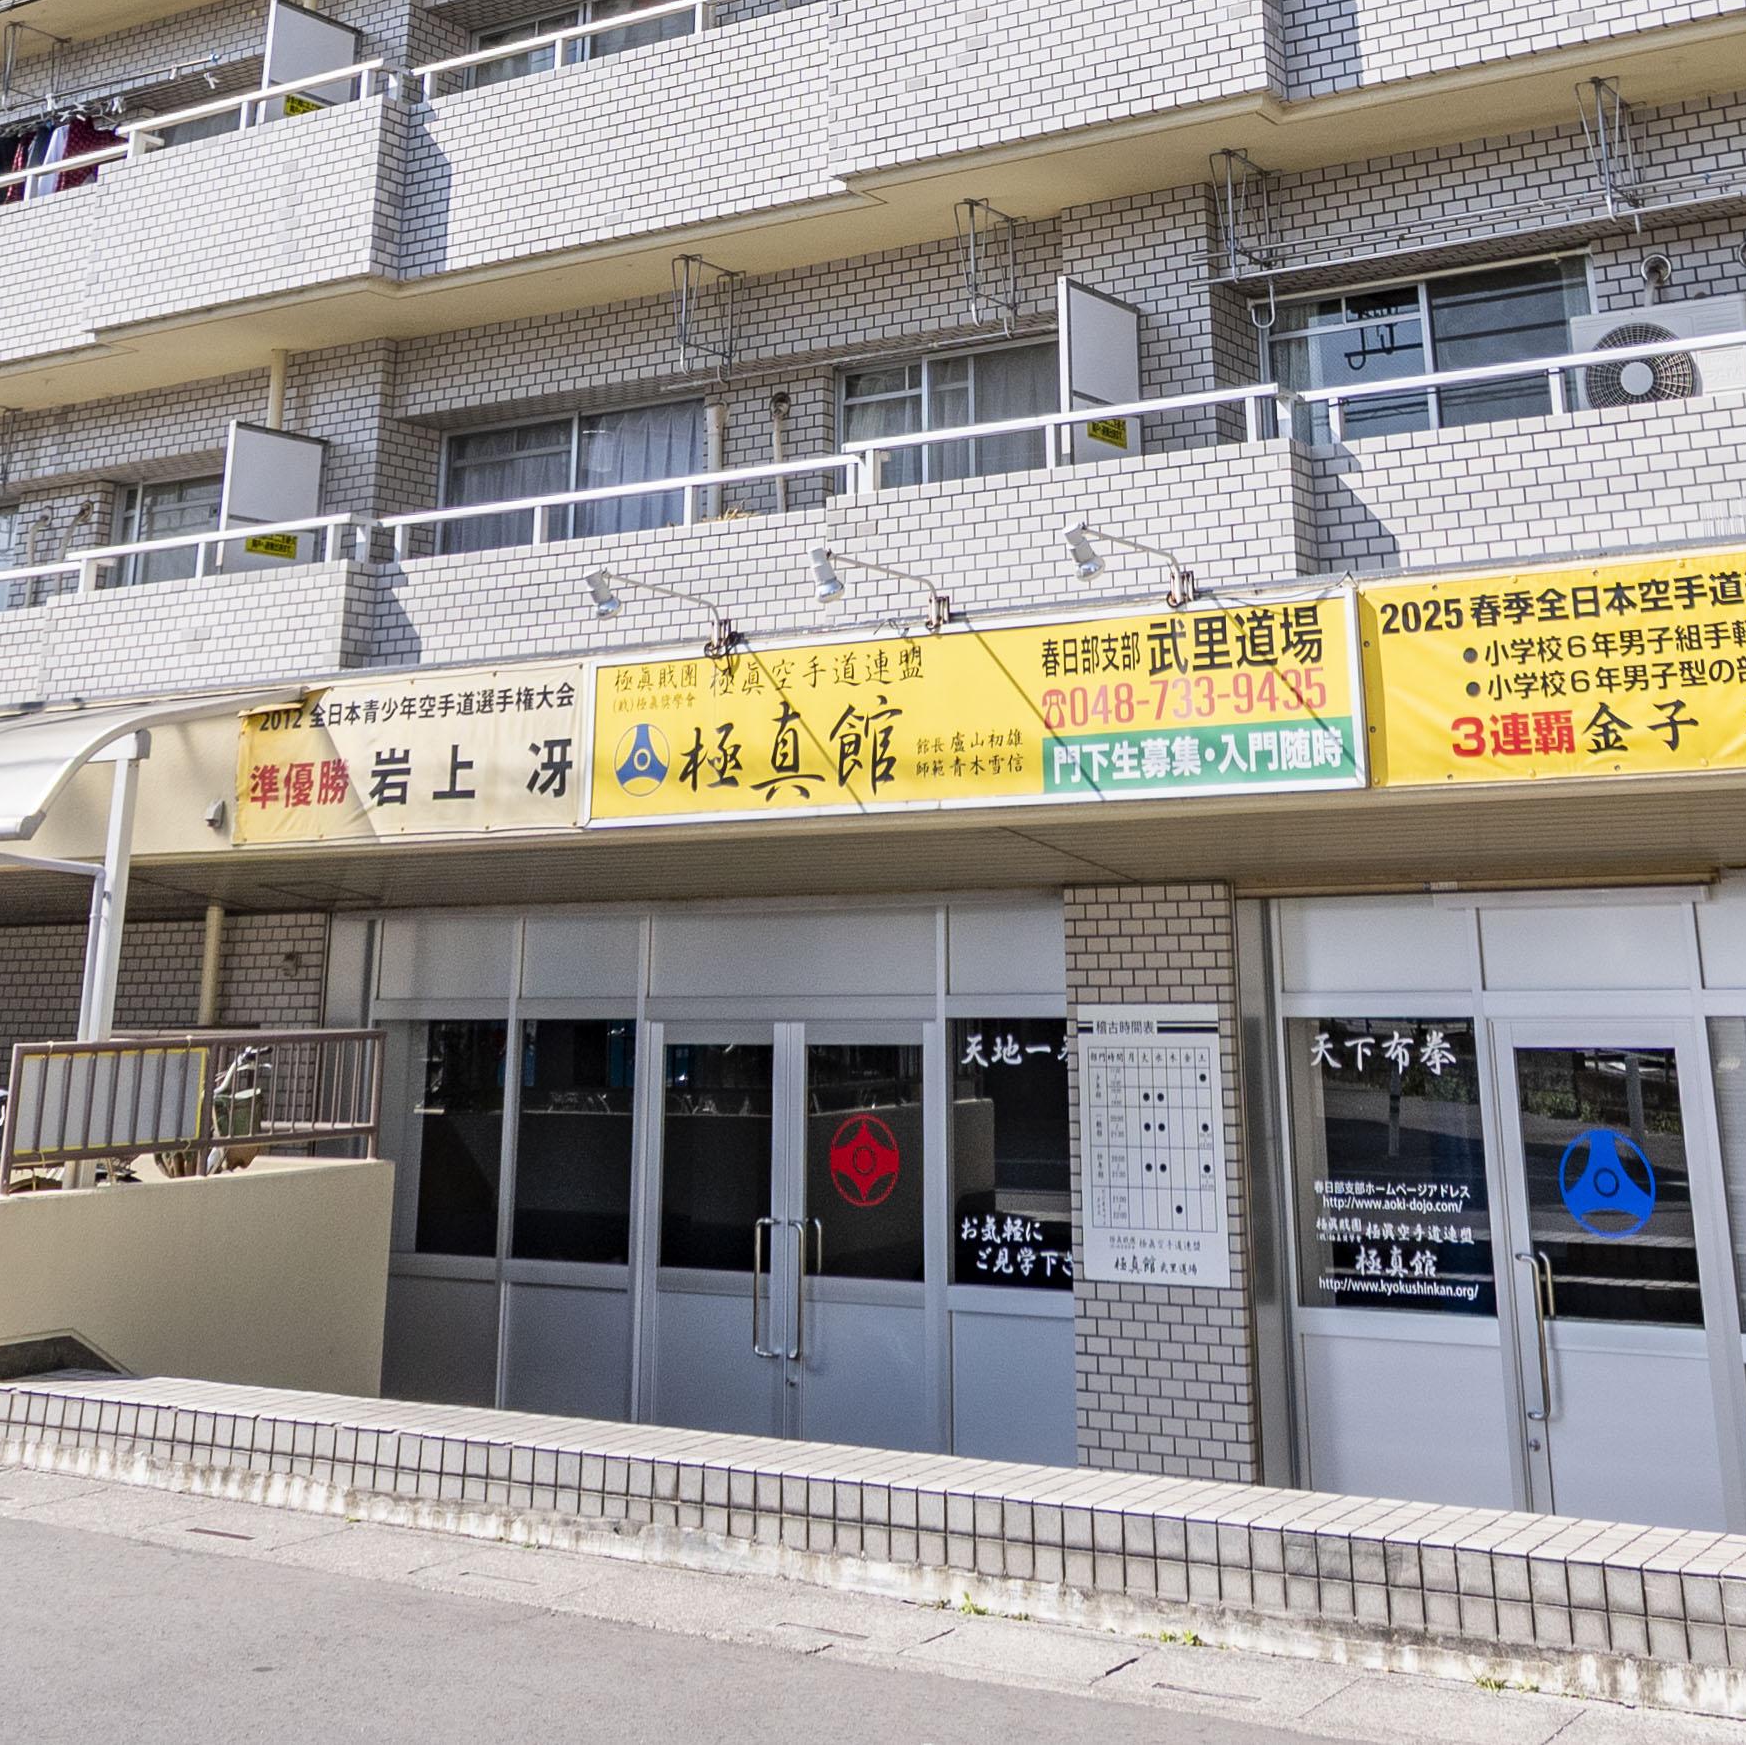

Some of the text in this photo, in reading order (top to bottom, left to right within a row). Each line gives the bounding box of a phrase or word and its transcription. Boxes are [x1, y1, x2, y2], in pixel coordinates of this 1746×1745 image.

[1380, 597, 1464, 635] 2025
[1041, 605, 1324, 678] 春日部支部 武里道場
[259, 681, 576, 732] 2012 全日本青少年空手道選手権大会
[1069, 666, 1327, 729] 048-733-9435
[678, 694, 904, 803] 極真館
[1053, 725, 1344, 785] 門下生募集・入門随時
[1450, 709, 1576, 758] 3連覇
[249, 757, 351, 811] 準優勝
[1310, 1030, 1457, 1076] 天下布拳
[961, 1214, 1043, 1245] お気軽に
[1322, 1195, 1463, 1215] http://www.aoki-dojo.com/
[1354, 1244, 1438, 1278] 極真館
[1318, 1276, 1479, 1301] http://www.kyokushinkan.org/
